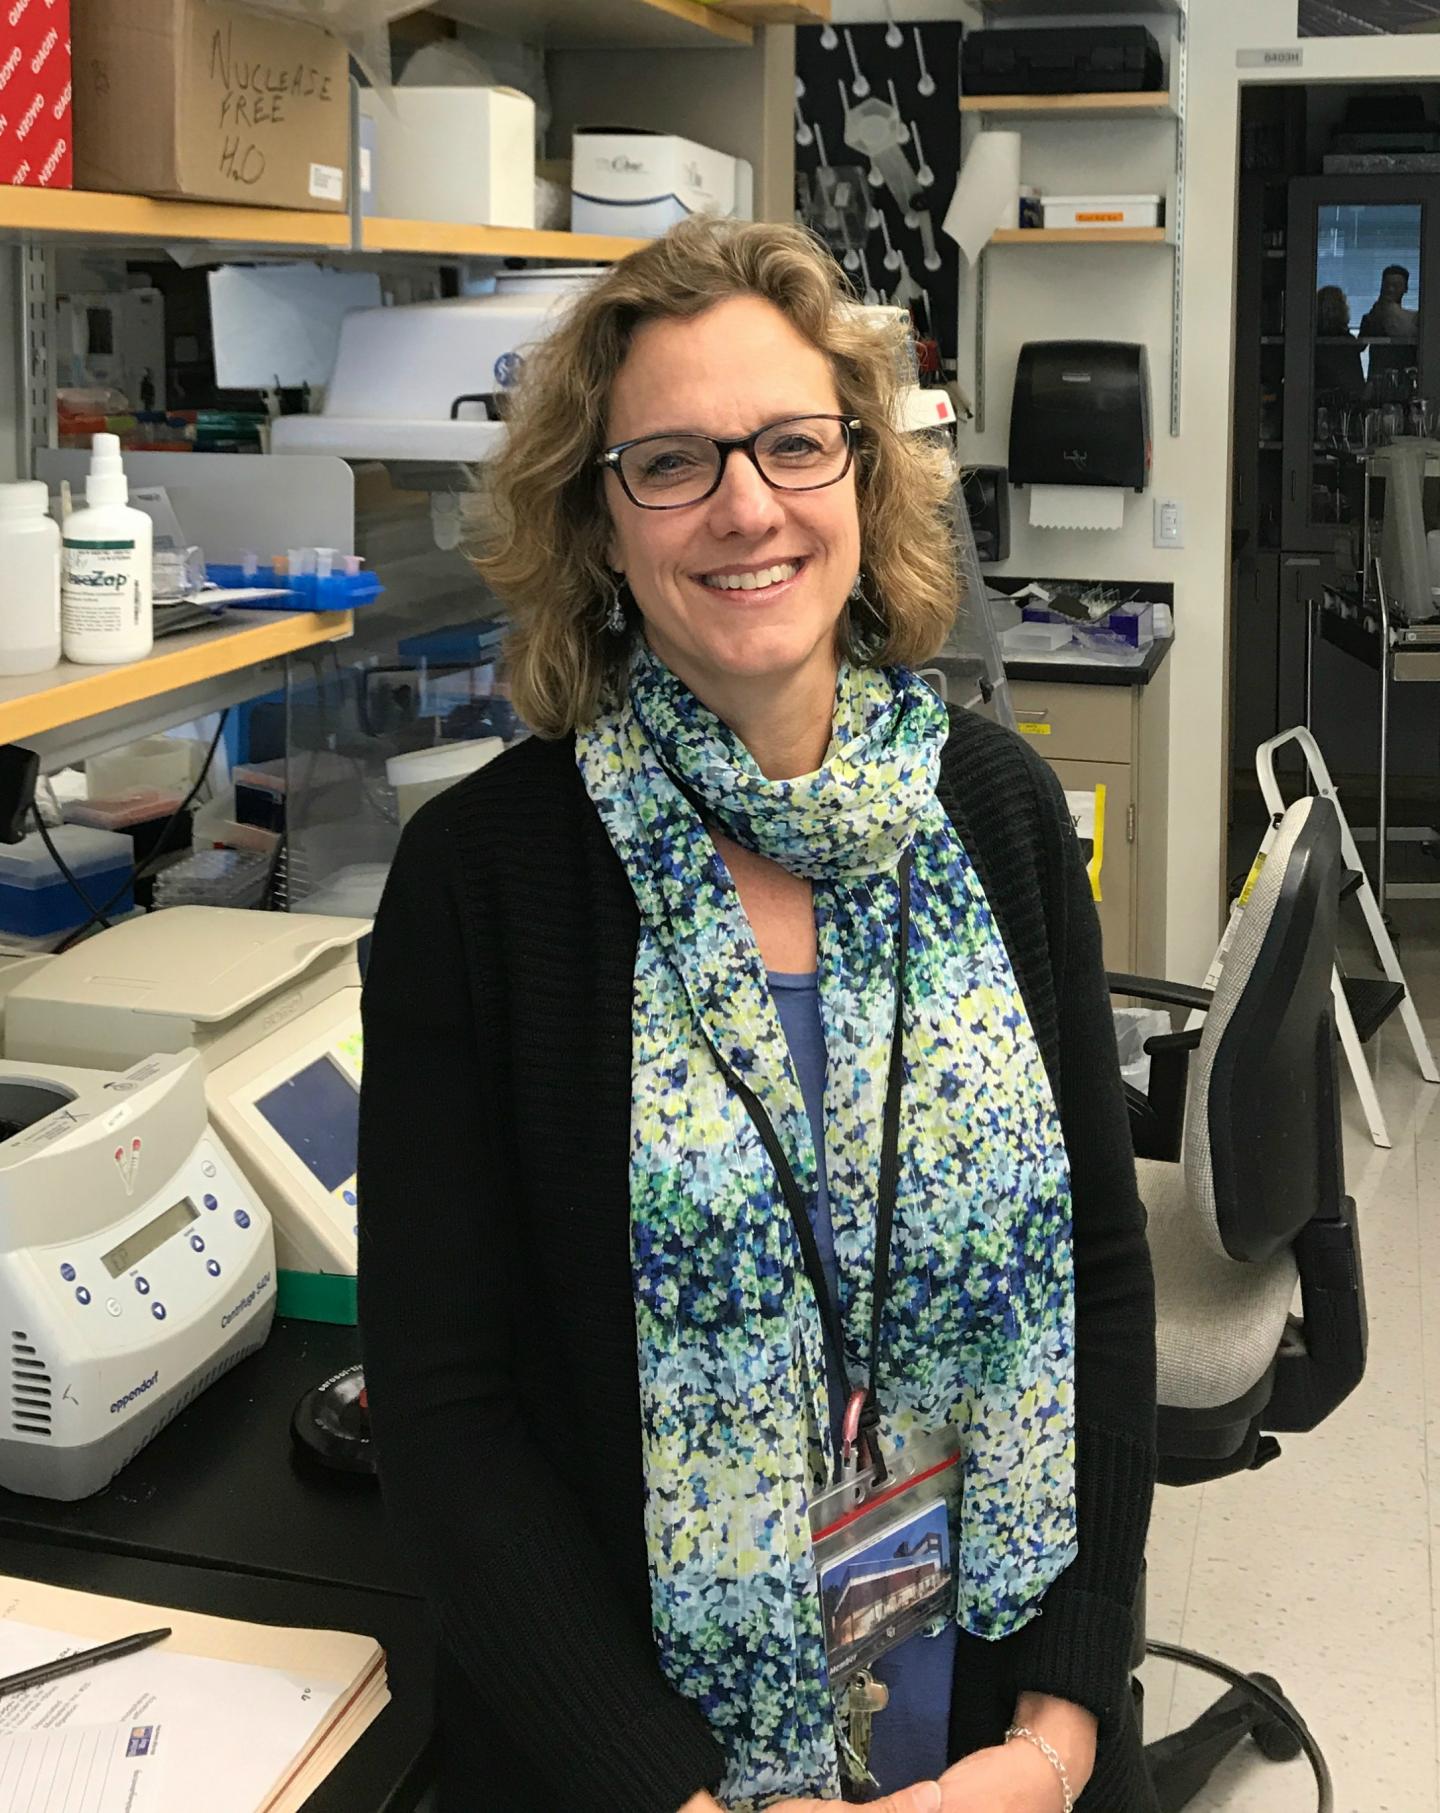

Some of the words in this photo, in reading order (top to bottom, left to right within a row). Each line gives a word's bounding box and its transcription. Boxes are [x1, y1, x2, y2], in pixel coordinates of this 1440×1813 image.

[31, 27, 59, 74] QIAGEN
[211, 20, 332, 101] NUCLEASE
[16, 93, 45, 142] QIAGEN
[219, 91, 285, 129] FREE
[38, 138, 67, 188] QIAGEN
[221, 1291, 256, 1329] Centrifuge
[110, 1369, 159, 1413] eppendorf
